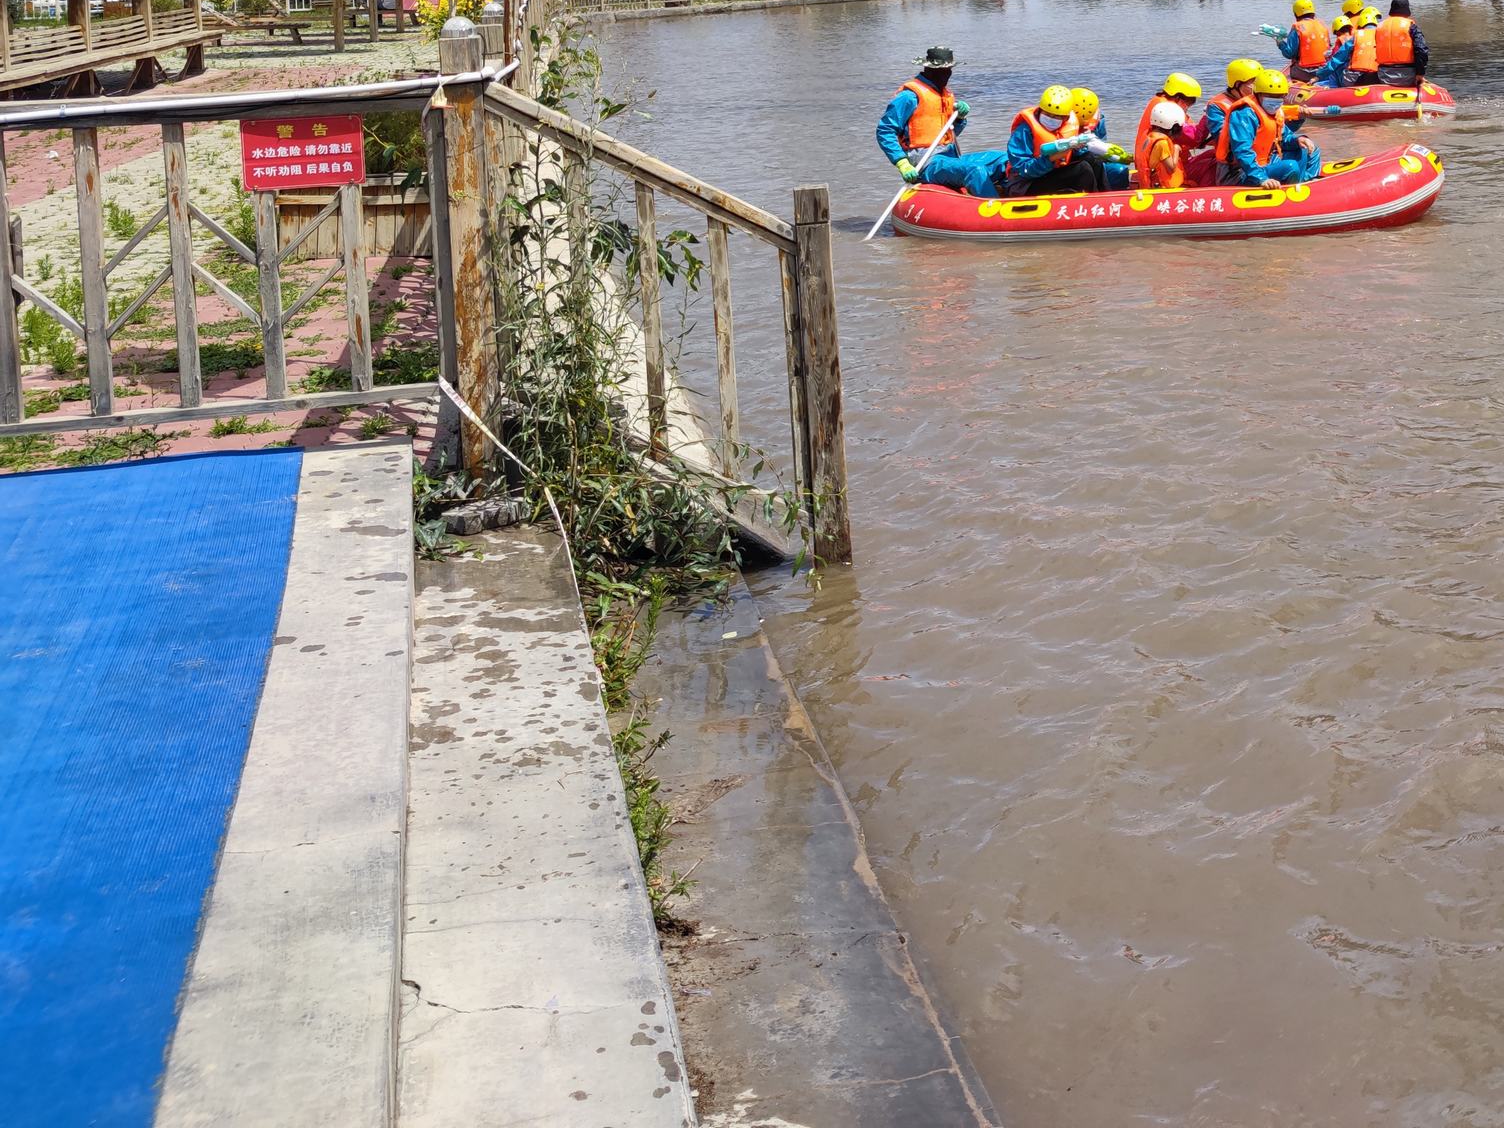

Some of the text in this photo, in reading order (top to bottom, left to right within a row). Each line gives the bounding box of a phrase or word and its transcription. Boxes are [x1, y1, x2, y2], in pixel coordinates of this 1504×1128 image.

[276, 123, 329, 139] 警告
[251, 142, 353, 159] 水边危险 请勿靠近
[253, 161, 354, 178] 不听劝阻 后果自负
[904, 203, 925, 223] 34
[1056, 197, 1225, 221] 天山红河 峡谷漂流
